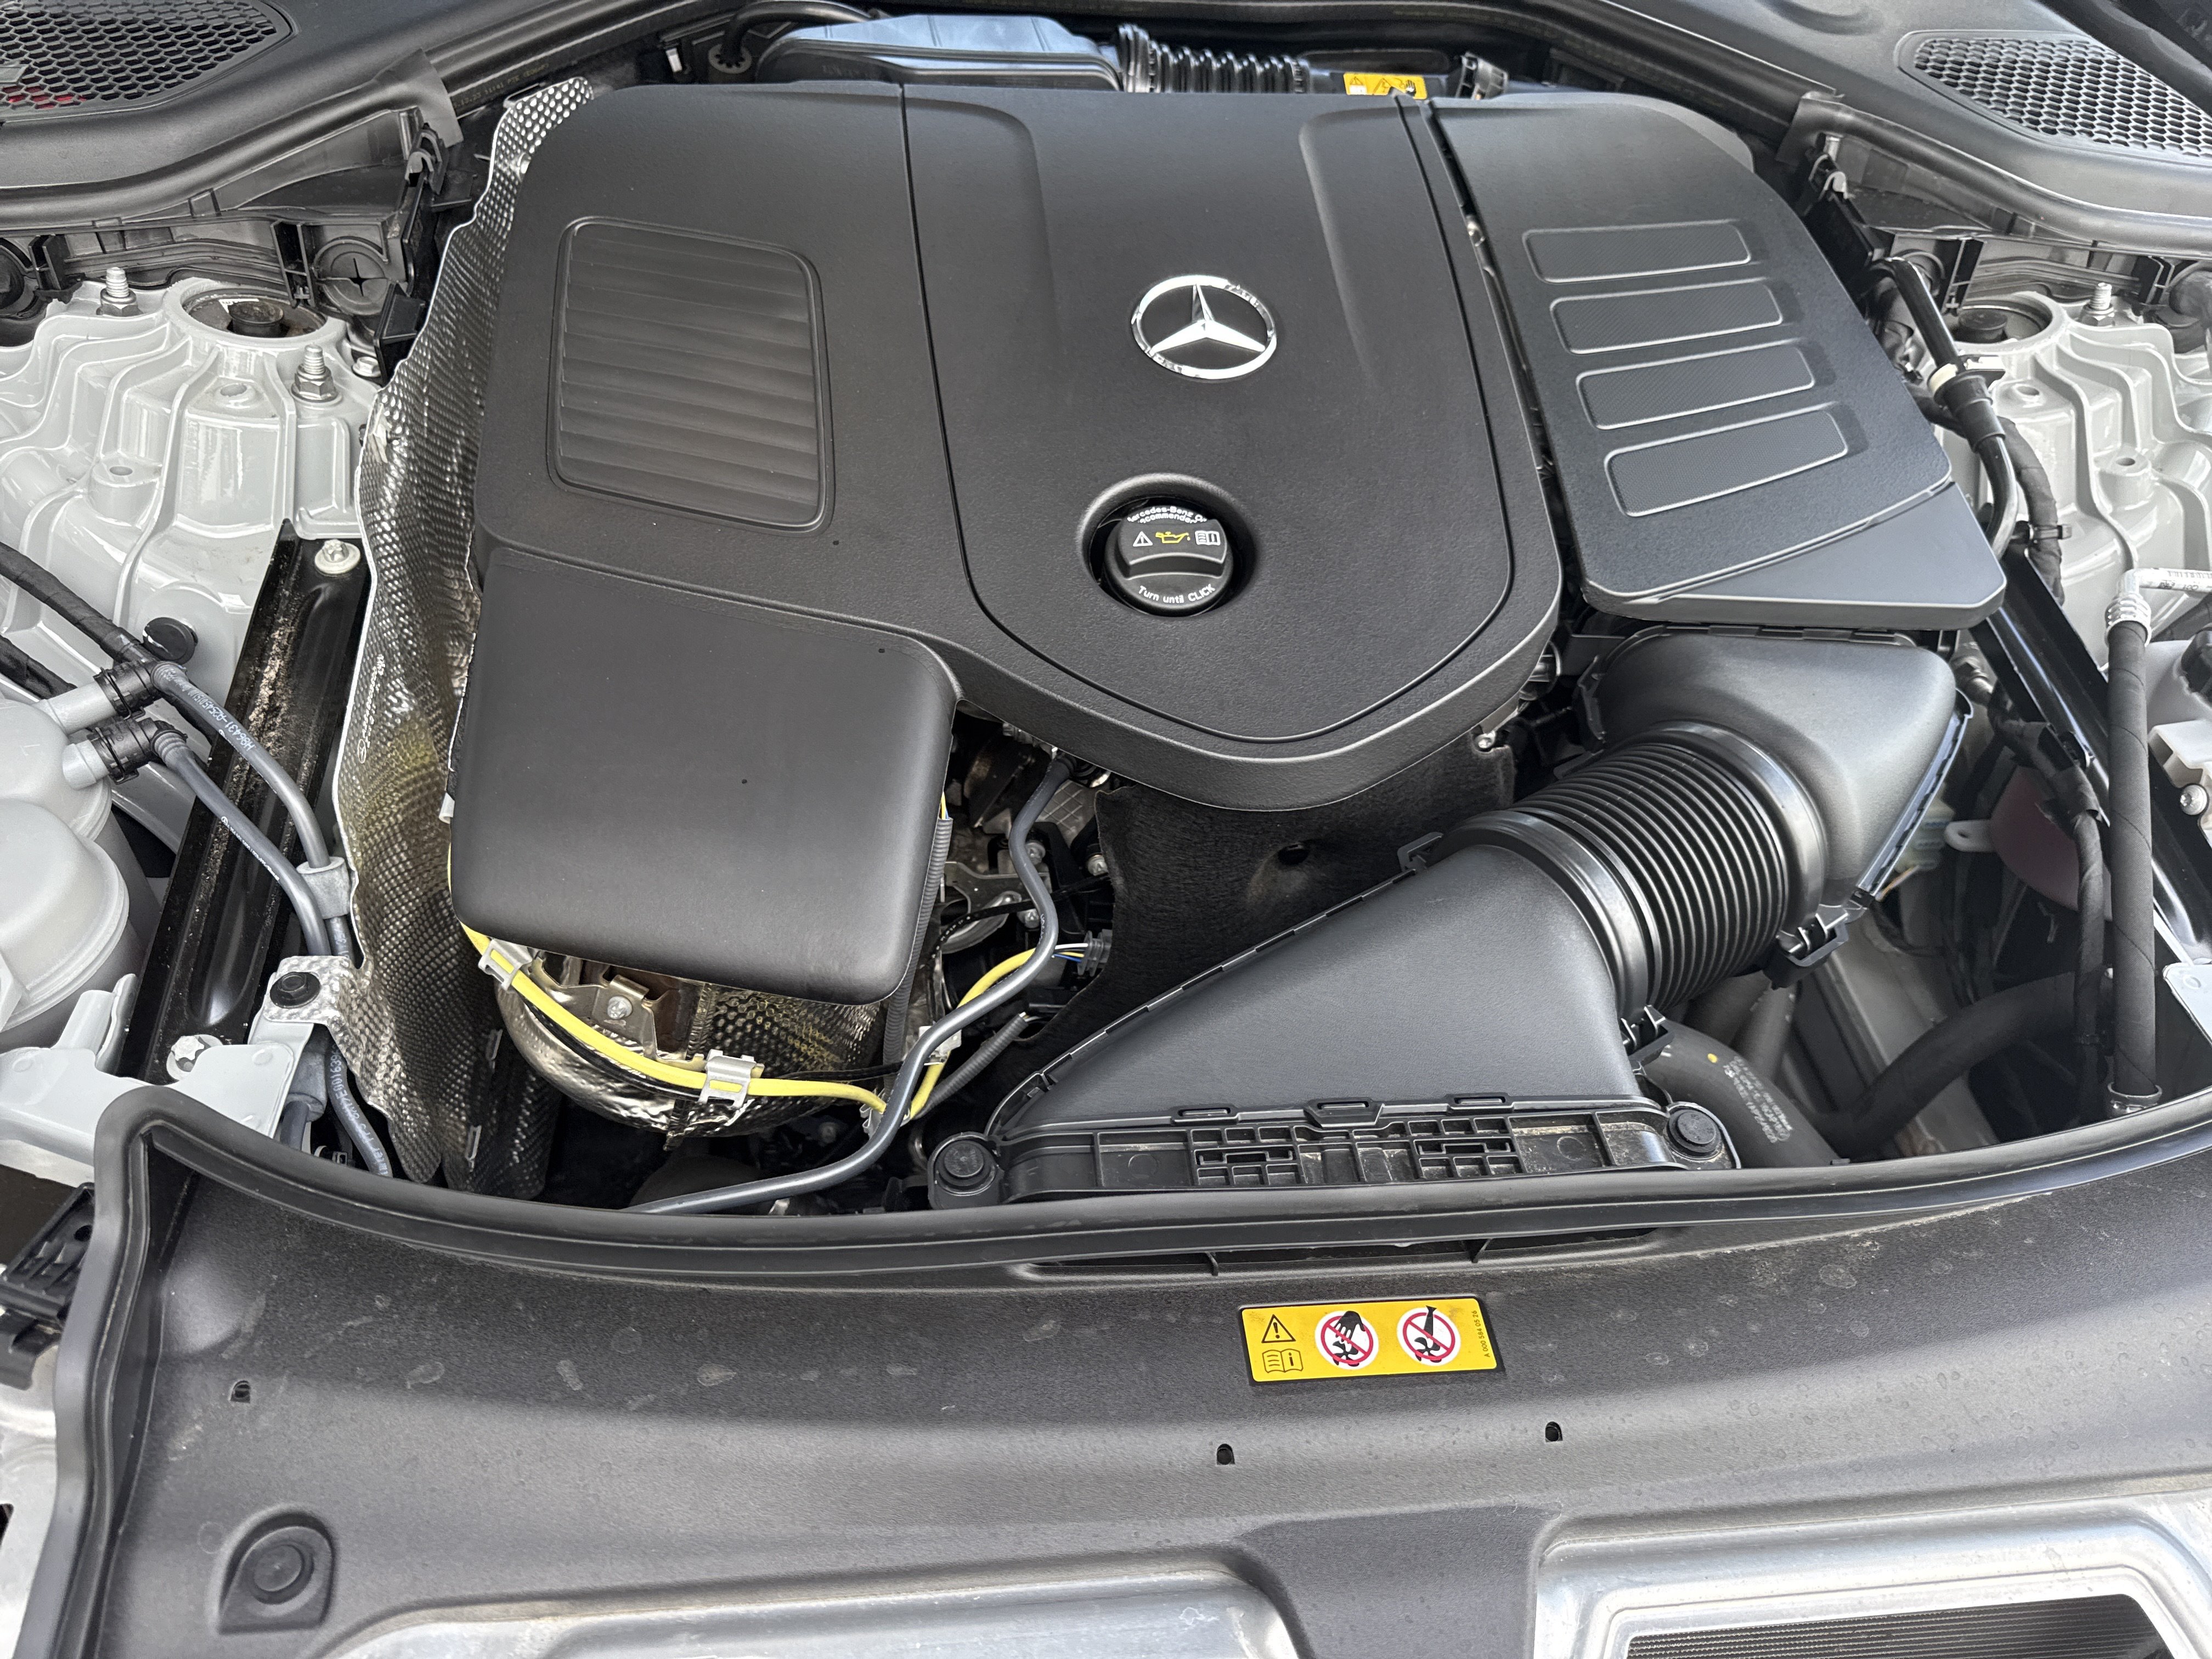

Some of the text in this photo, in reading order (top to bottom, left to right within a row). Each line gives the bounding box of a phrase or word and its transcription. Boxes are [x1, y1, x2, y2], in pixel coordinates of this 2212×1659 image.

[1138, 583, 1216, 603] Turn until CLICK
[1480, 1340, 1488, 1352] 000
